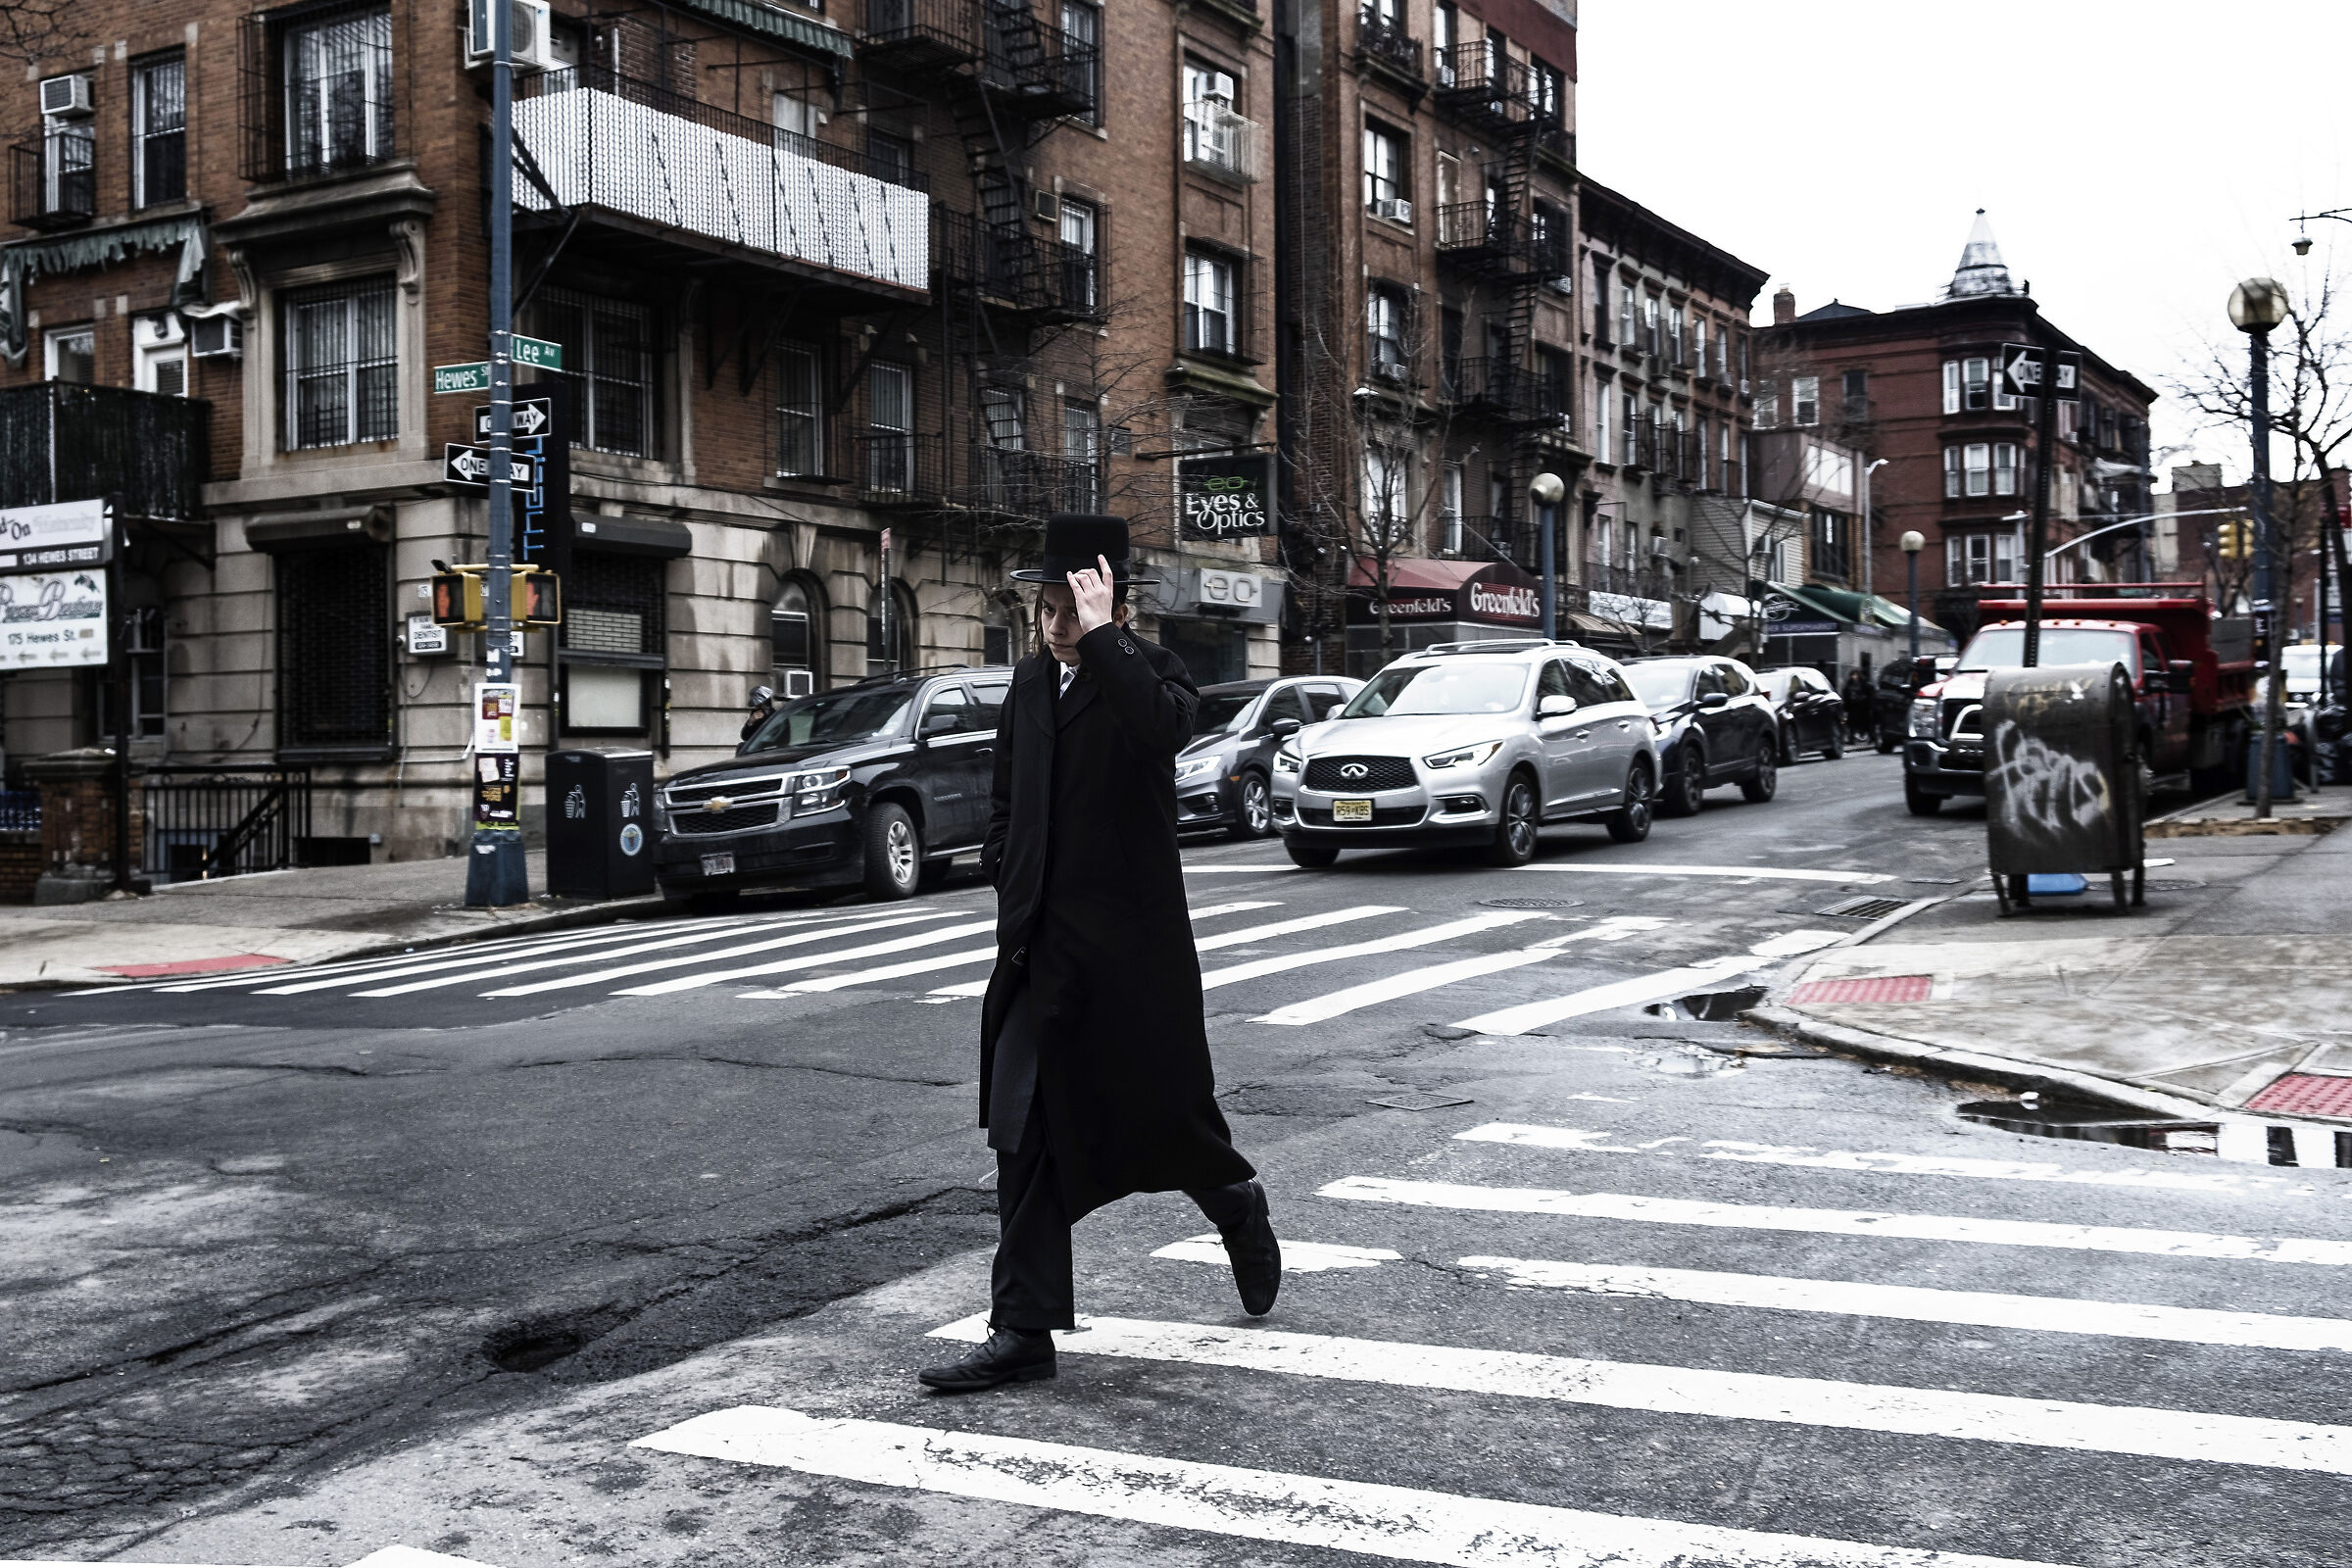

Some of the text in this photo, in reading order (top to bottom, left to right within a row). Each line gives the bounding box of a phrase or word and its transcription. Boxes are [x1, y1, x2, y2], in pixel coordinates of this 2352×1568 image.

[515, 339, 555, 363] Lee Av
[434, 369, 477, 390] Hewes
[515, 412, 538, 426] WAY
[461, 457, 487, 473] ONE
[1186, 493, 1259, 520] Eyes &
[1197, 509, 1265, 534] Optics
[413, 629, 443, 641] DENTIST
